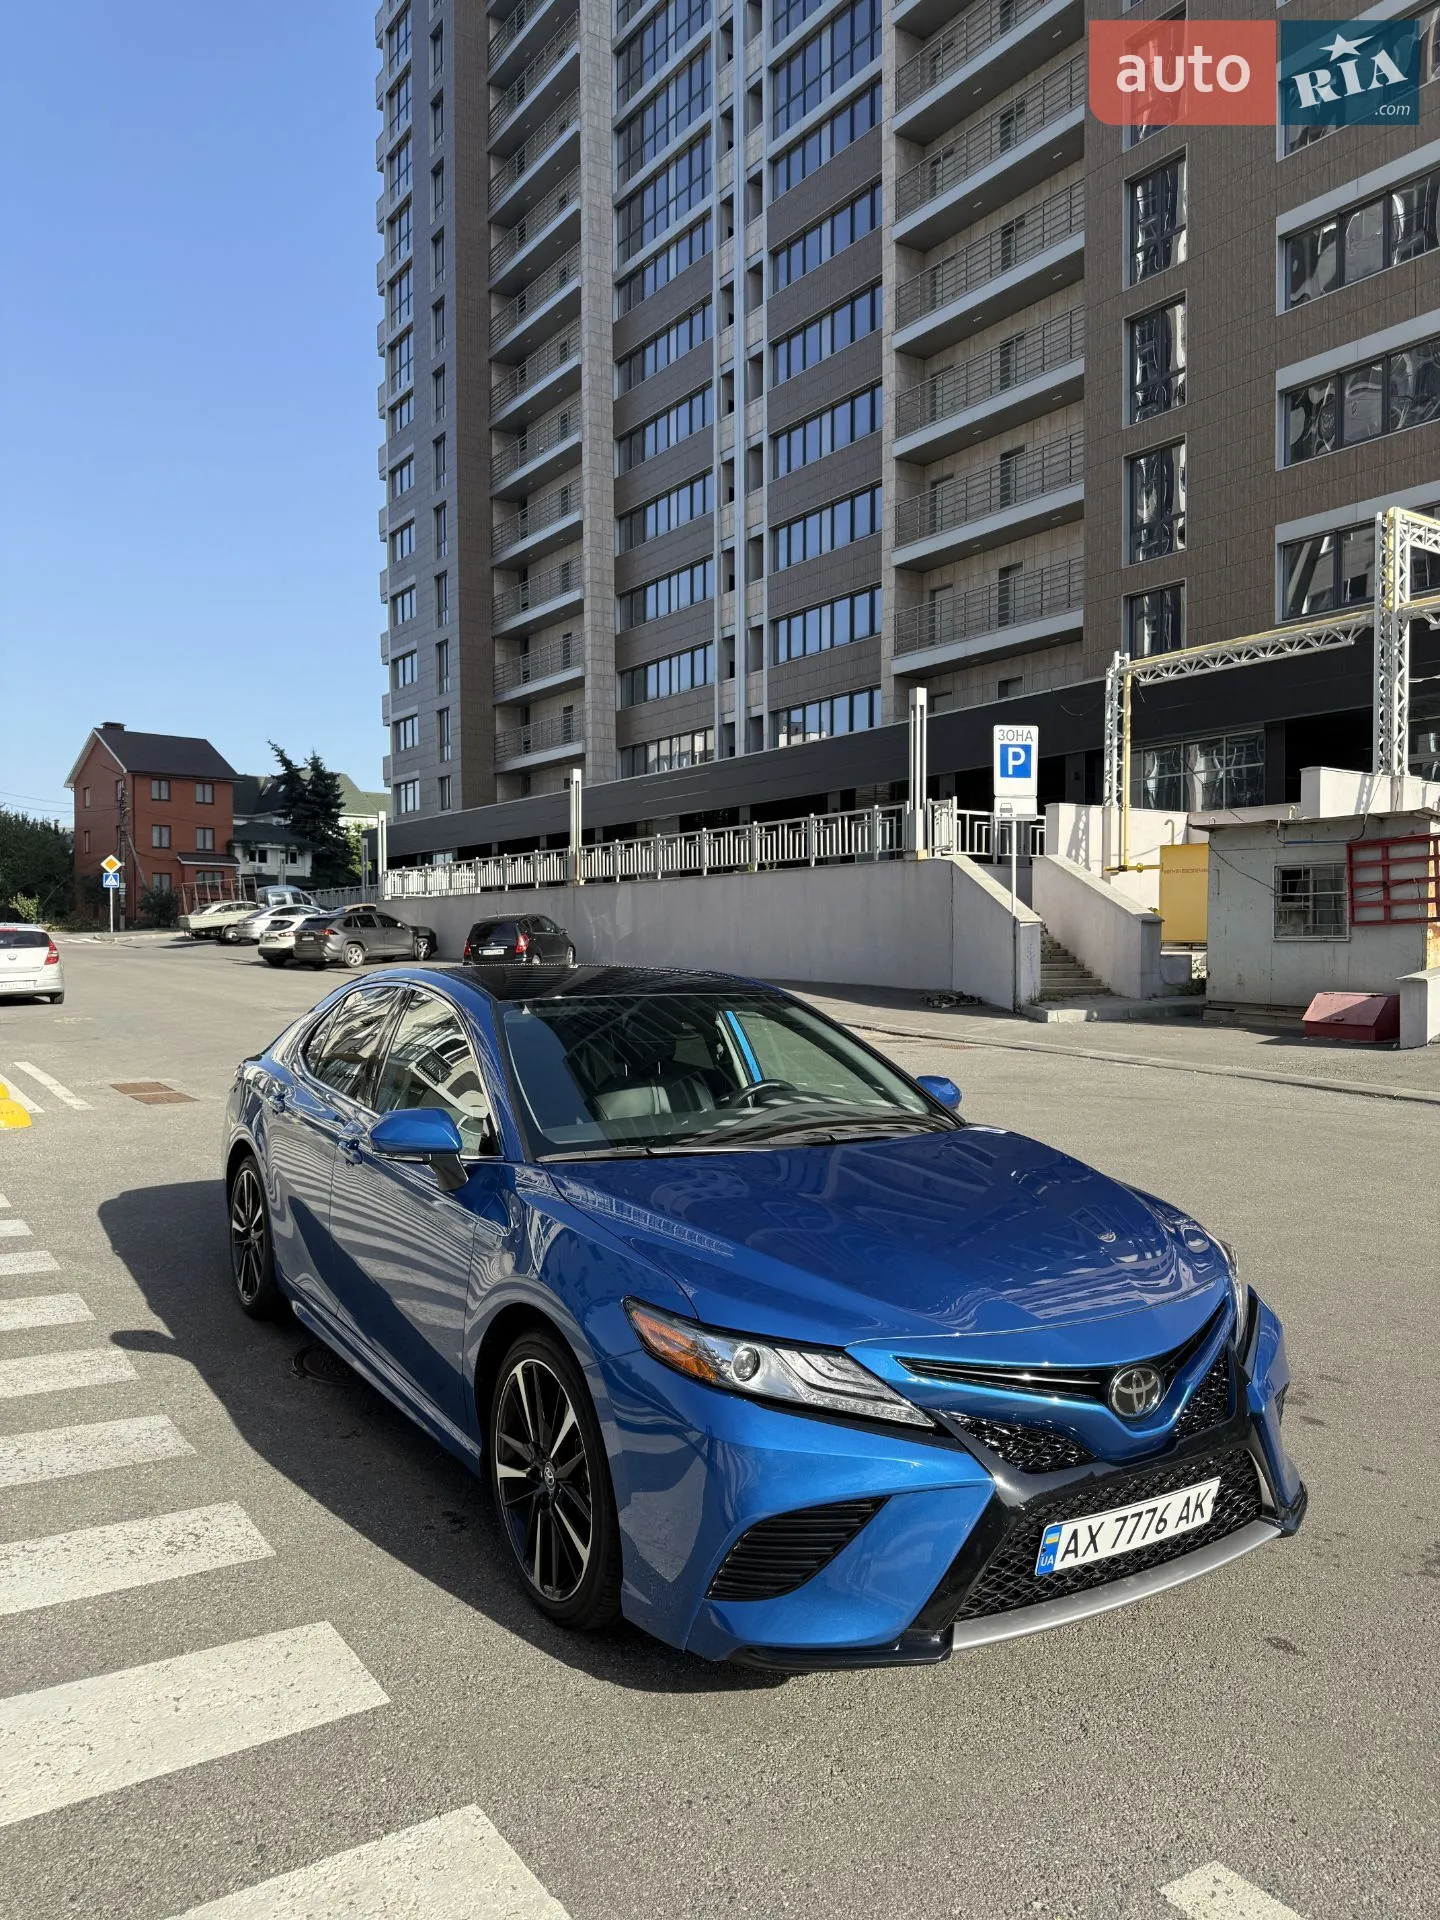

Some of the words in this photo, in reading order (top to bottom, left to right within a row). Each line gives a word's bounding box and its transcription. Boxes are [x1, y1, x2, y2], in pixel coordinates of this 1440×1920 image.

[998, 729, 1034, 742] ЗОНА
[1008, 747, 1026, 775] P
[1060, 1521, 1105, 1562] AX
[1111, 1502, 1172, 1549] 7776
[1174, 1488, 1212, 1529] AK
[1040, 1554, 1055, 1567] UA
